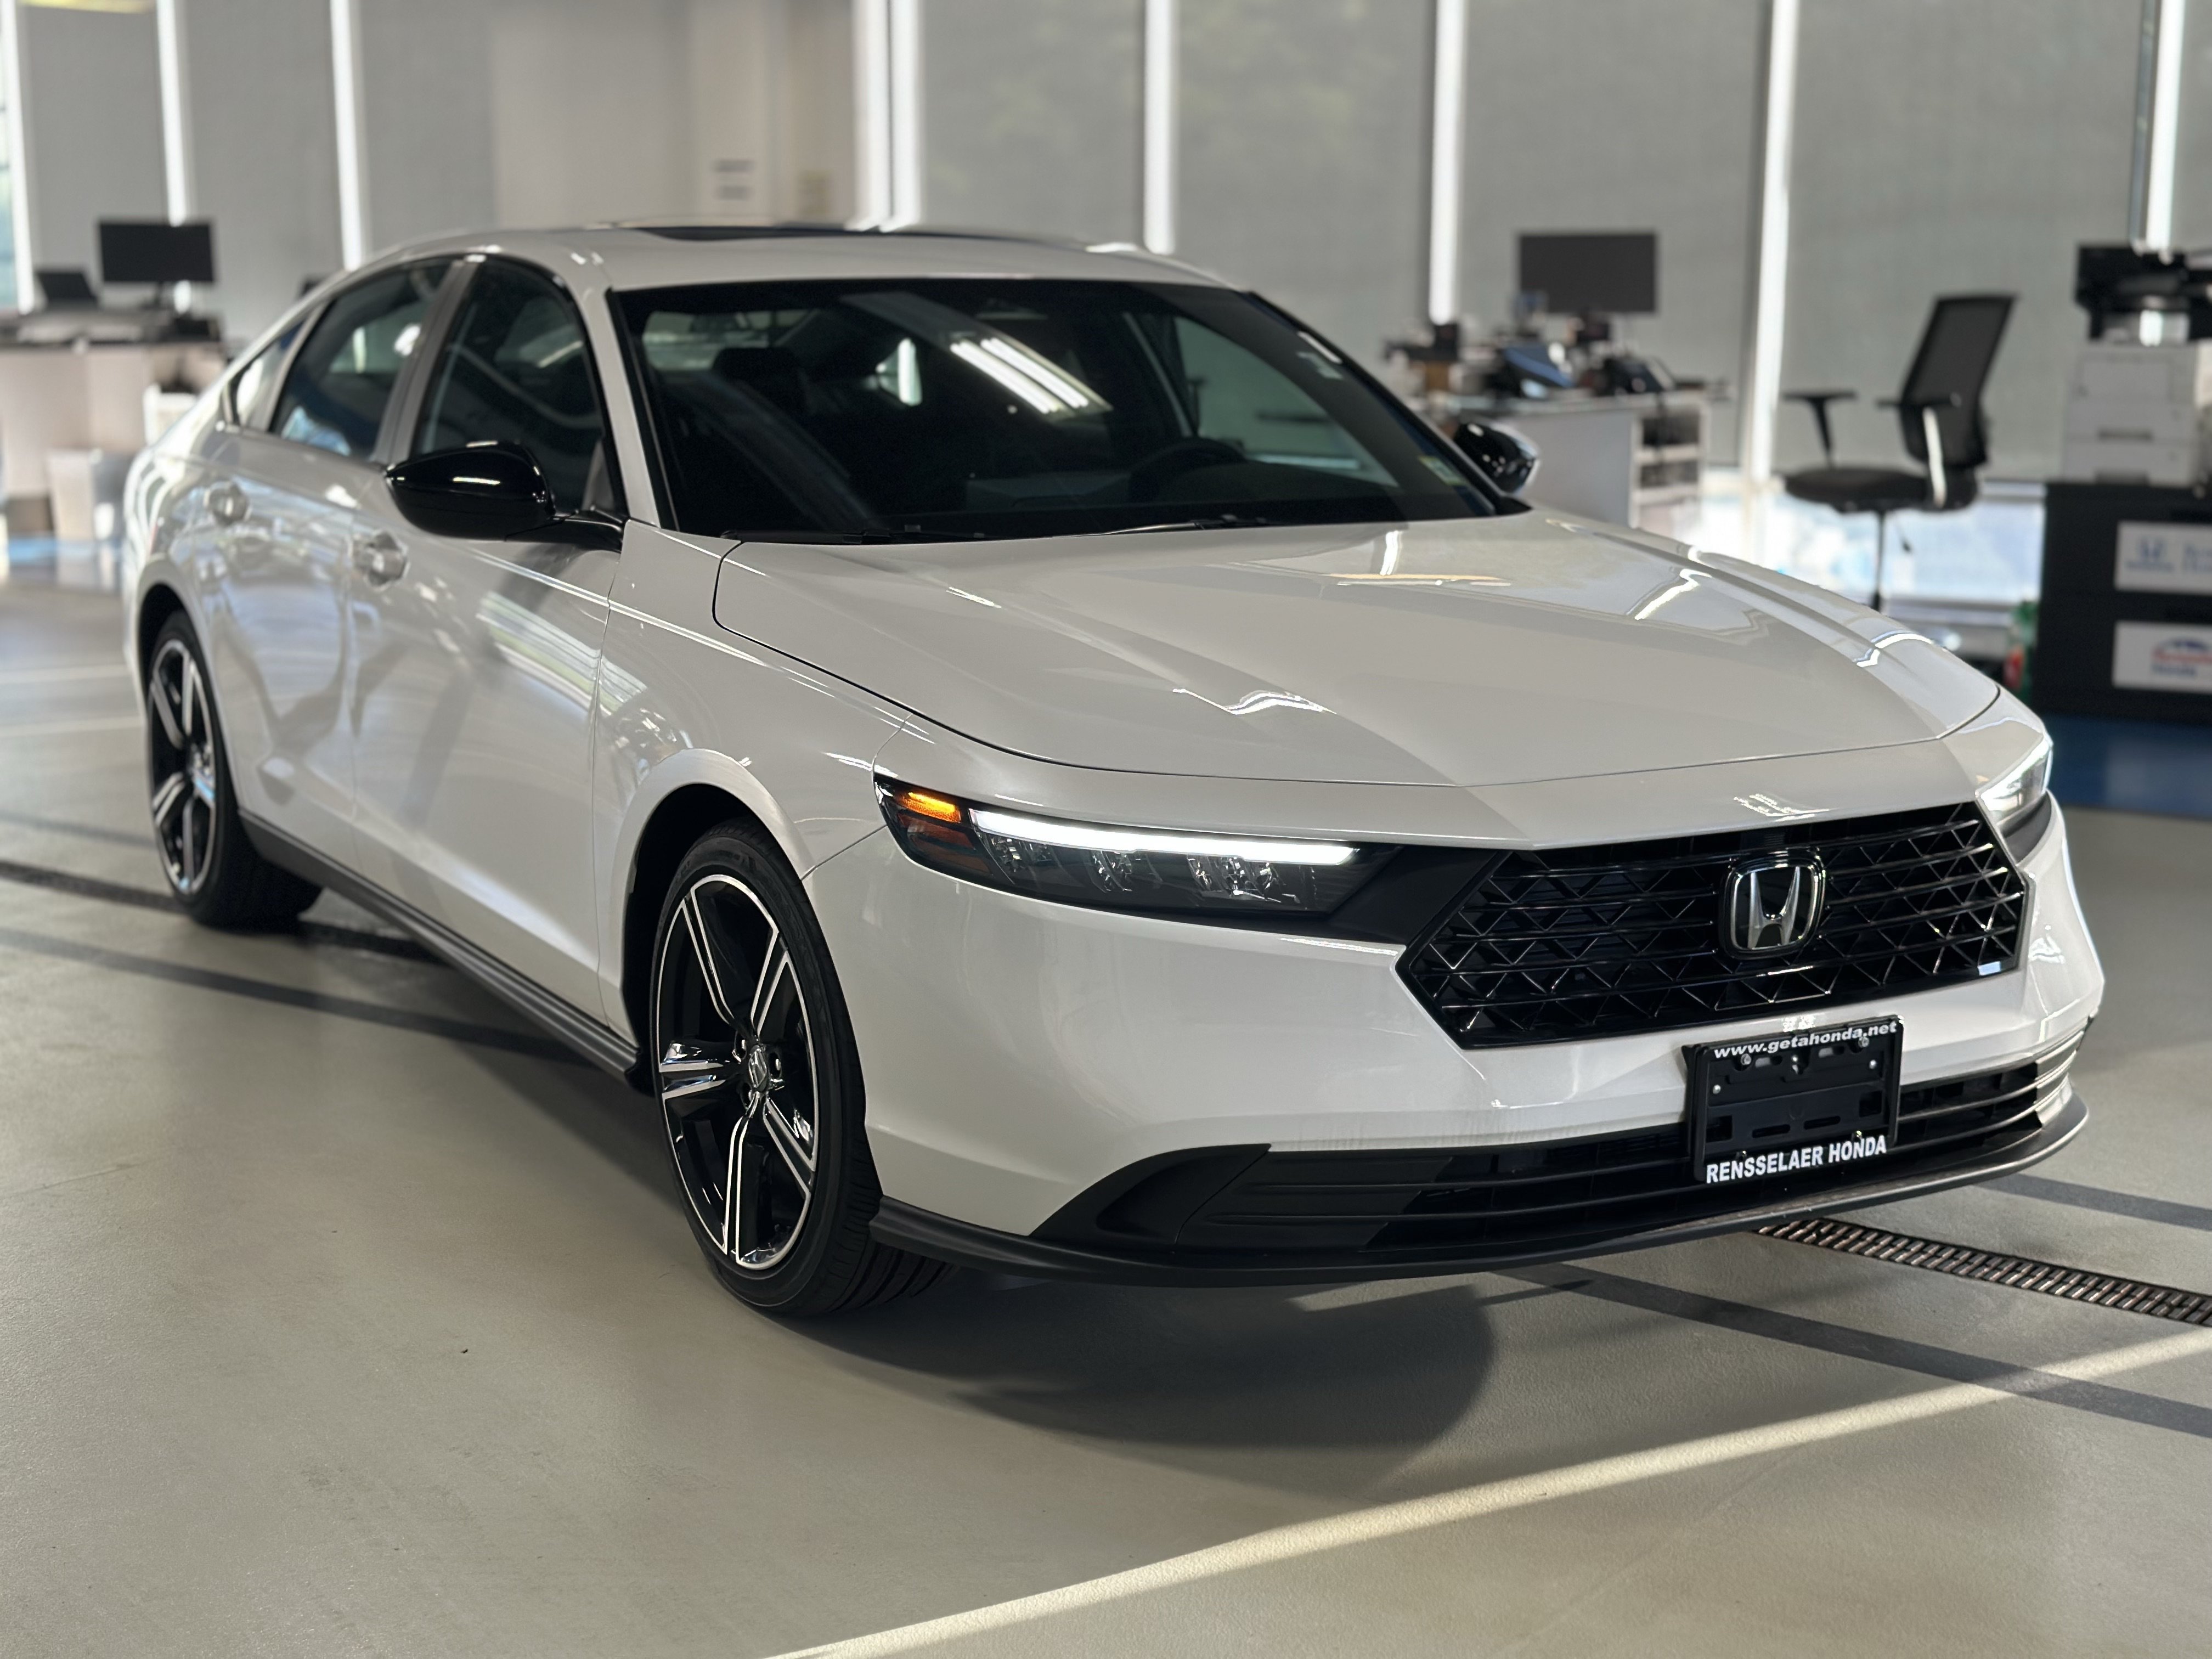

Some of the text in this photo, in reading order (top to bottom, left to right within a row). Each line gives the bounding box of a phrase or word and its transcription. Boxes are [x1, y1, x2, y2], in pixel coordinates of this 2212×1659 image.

[1714, 1020, 1897, 1058] www.getahonda.net
[1706, 1135, 1887, 1183] RENSSELAER HONDA
